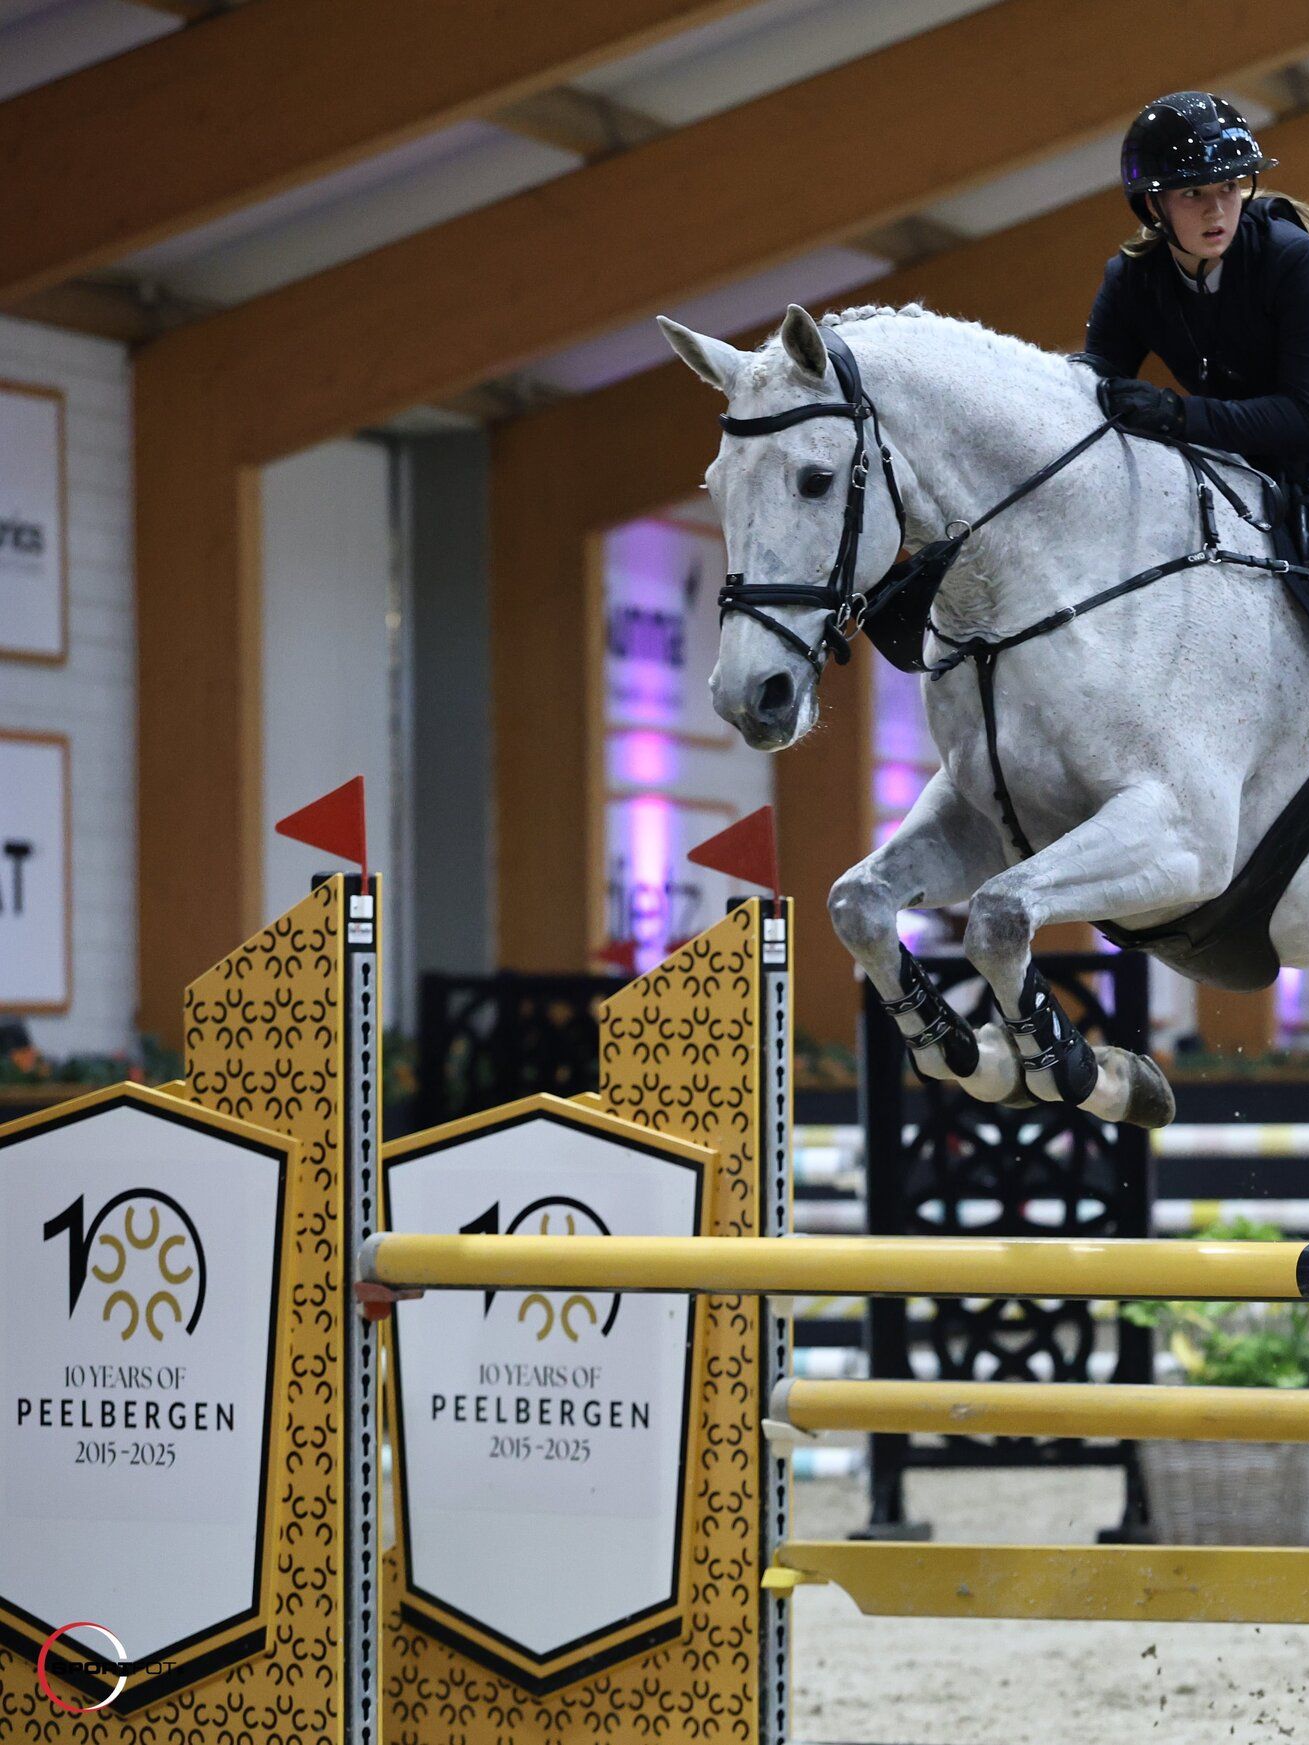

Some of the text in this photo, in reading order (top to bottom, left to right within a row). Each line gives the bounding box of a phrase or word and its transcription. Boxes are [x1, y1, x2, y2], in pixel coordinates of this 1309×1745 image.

[64, 1365, 187, 1390] 10 YEARS OF
[479, 1363, 603, 1389] 10 YEARS OF
[17, 1397, 235, 1432] PEELBERGEN
[431, 1394, 650, 1430] PEELBERGEN
